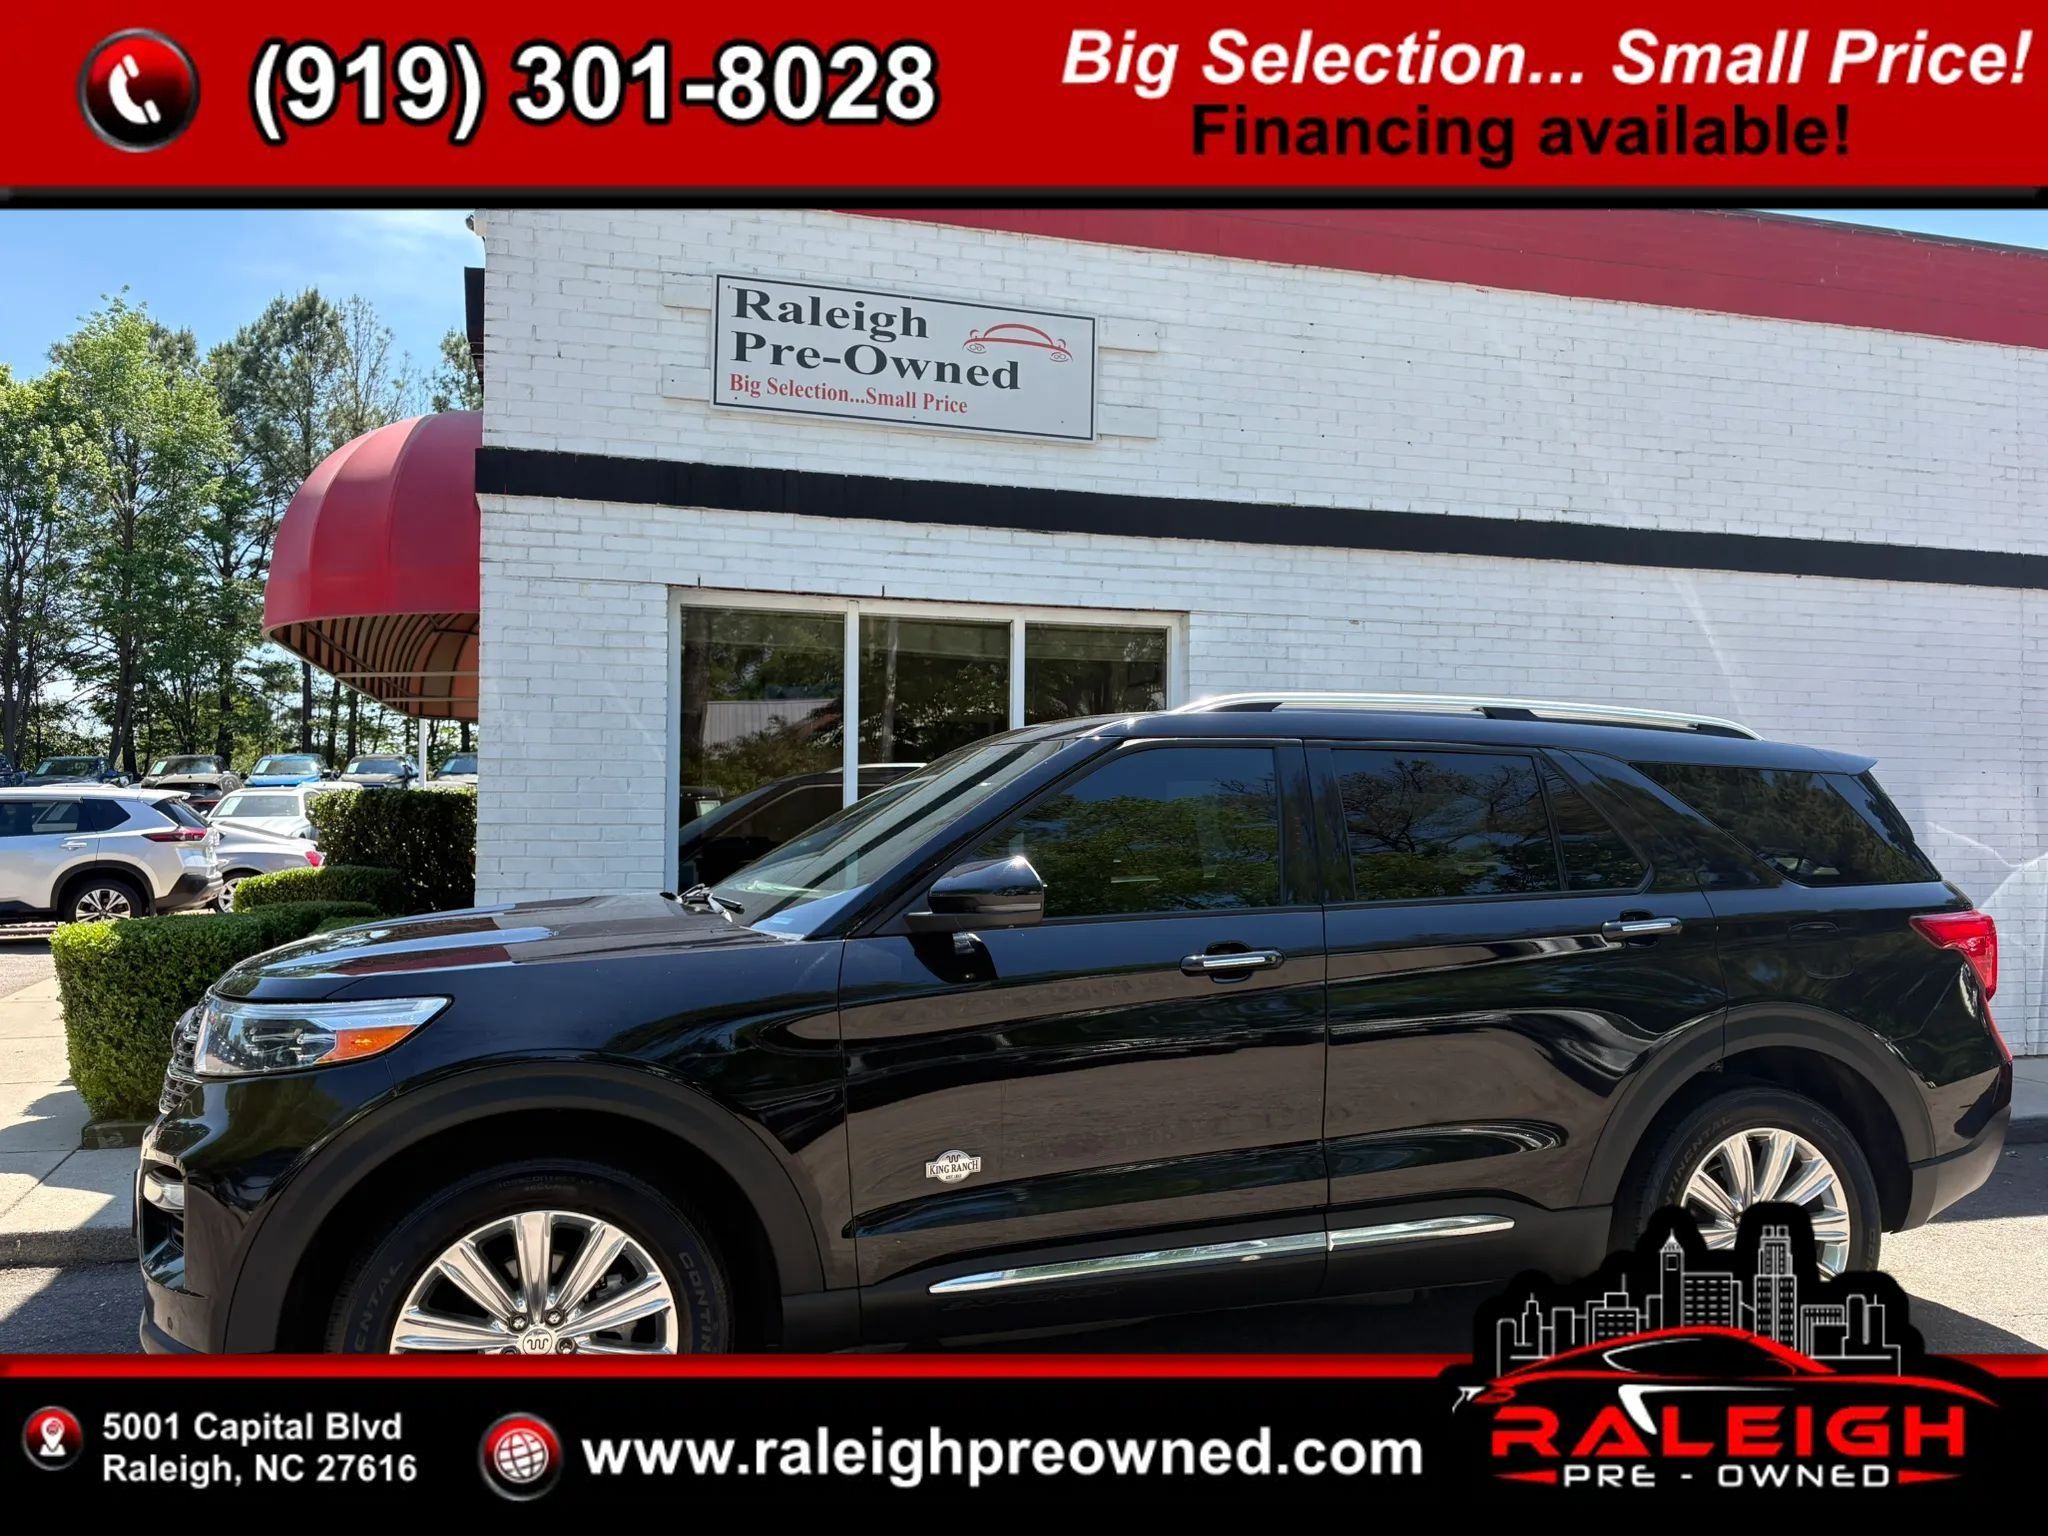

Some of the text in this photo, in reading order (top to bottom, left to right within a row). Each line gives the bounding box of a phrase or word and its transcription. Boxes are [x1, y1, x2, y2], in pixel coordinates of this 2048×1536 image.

[730, 286, 930, 344] Raleigh
[729, 330, 1022, 391] Pre-Owned
[729, 373, 761, 399] Big
[922, 392, 968, 415] Price
[929, 1159, 978, 1175] KING RANCH
